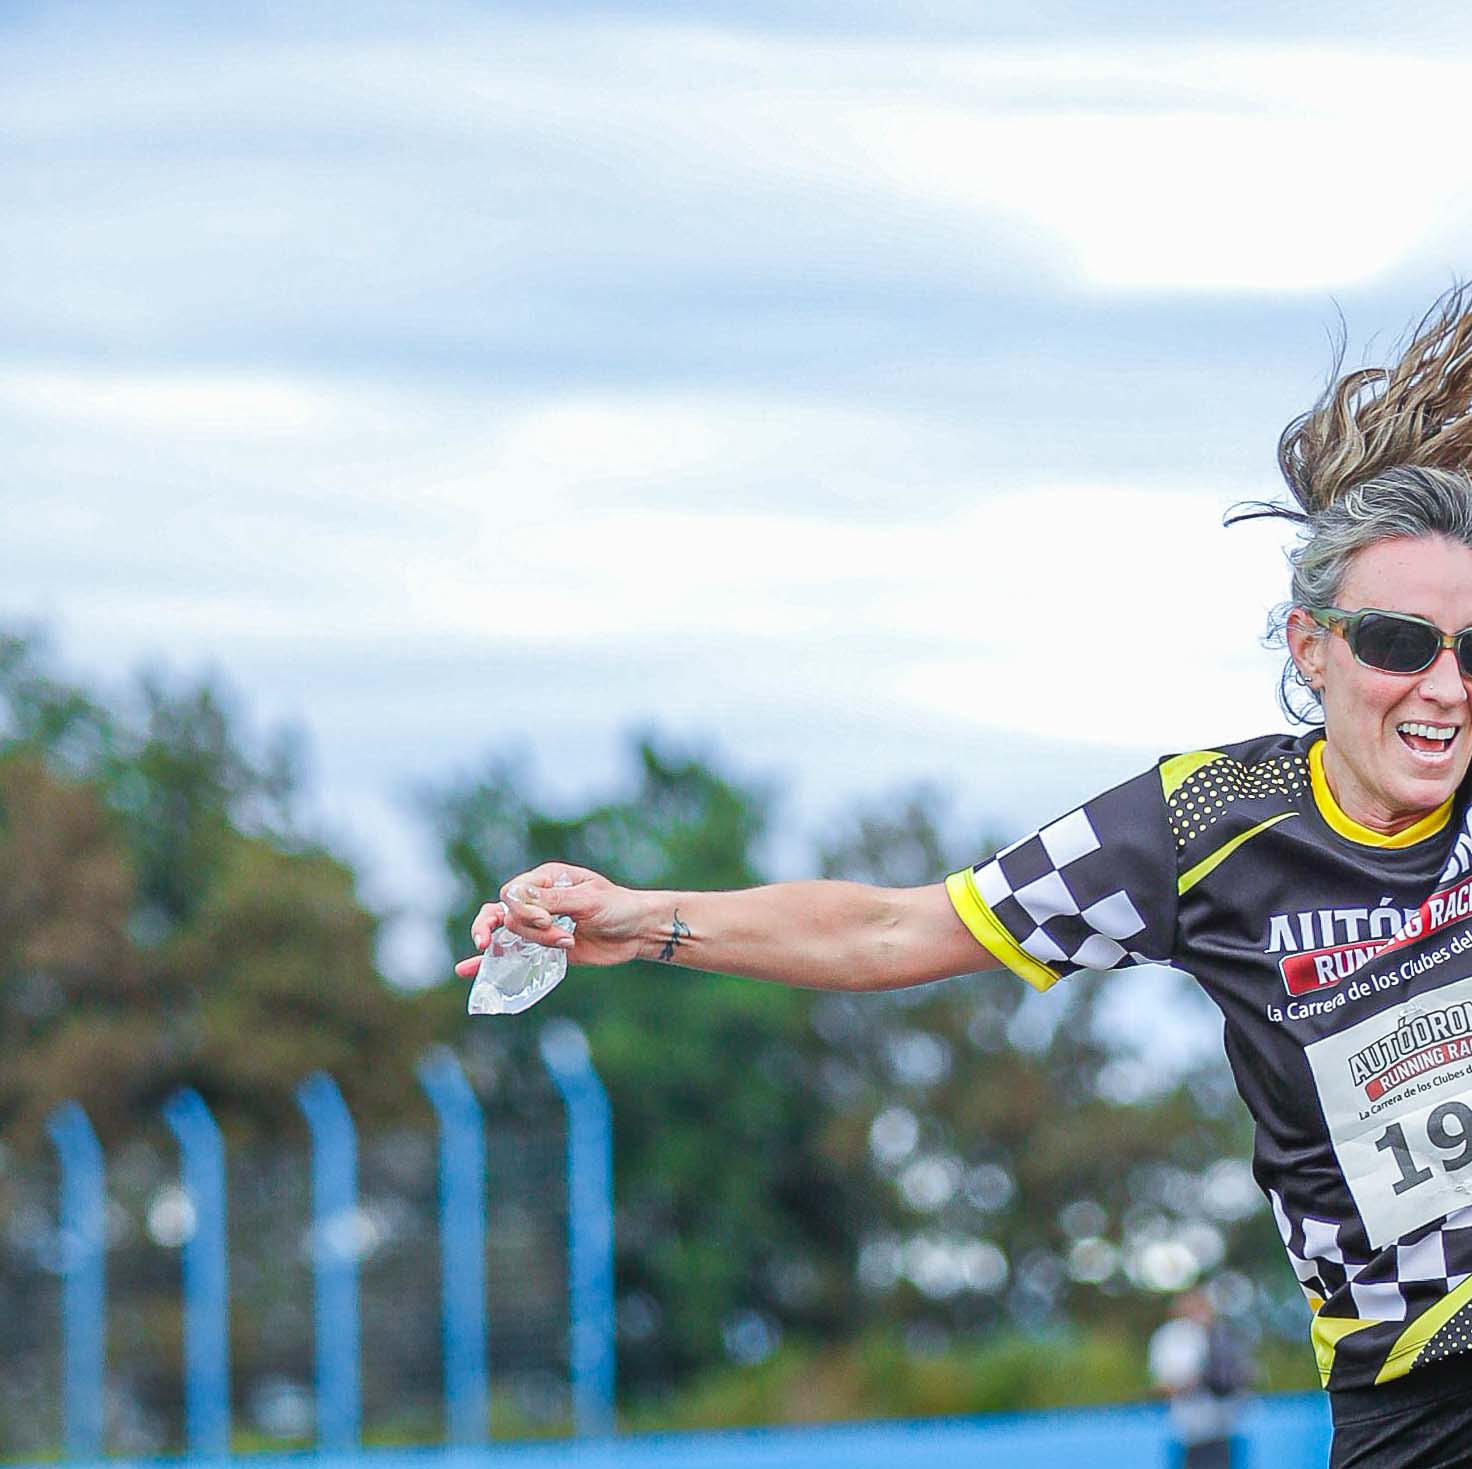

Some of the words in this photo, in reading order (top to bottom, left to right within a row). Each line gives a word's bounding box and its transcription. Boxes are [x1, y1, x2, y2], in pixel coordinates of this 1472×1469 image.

[1313, 909, 1424, 985] RUNG
[1286, 992, 1347, 1021] Carrera
[1348, 981, 1372, 1001] de
[1371, 971, 1400, 994] los
[1400, 945, 1451, 980] Clubes
[1358, 1111, 1371, 1121] La
[1370, 1094, 1403, 1115] Carrera
[1403, 1088, 1417, 1099] de
[1416, 1081, 1432, 1093] los
[1432, 1067, 1465, 1087] Clubes
[1380, 1047, 1445, 1092] RUNNING
